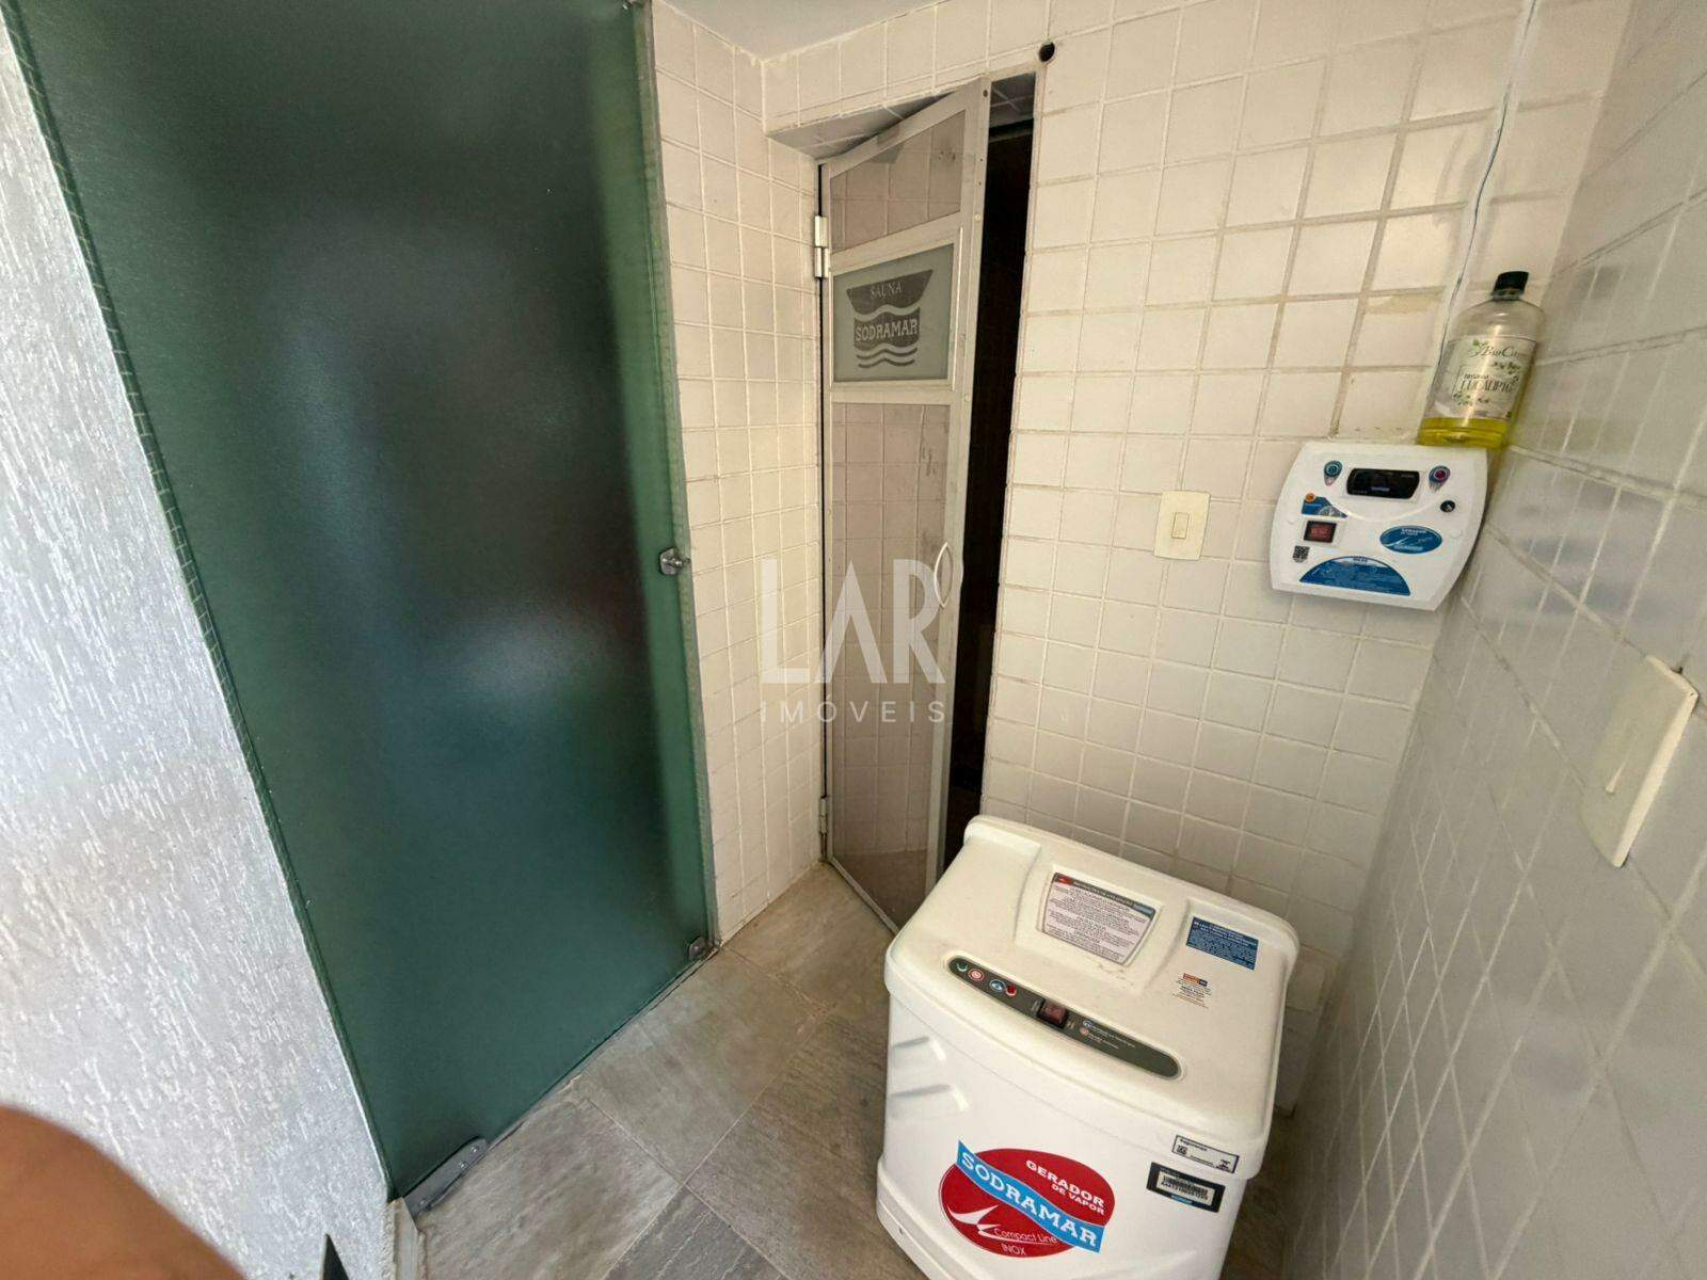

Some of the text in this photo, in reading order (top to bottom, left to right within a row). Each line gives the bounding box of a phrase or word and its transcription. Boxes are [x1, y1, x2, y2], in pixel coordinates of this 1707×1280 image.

[856, 318, 918, 341] SODRAMAR
[1025, 1159, 1105, 1207] GERADOR
[961, 1152, 1097, 1247] SODRAMAR
[1051, 1183, 1105, 1215] DE VAPOR
[994, 1227, 1058, 1245] Compact Line
[1001, 1243, 1026, 1256] INOX
